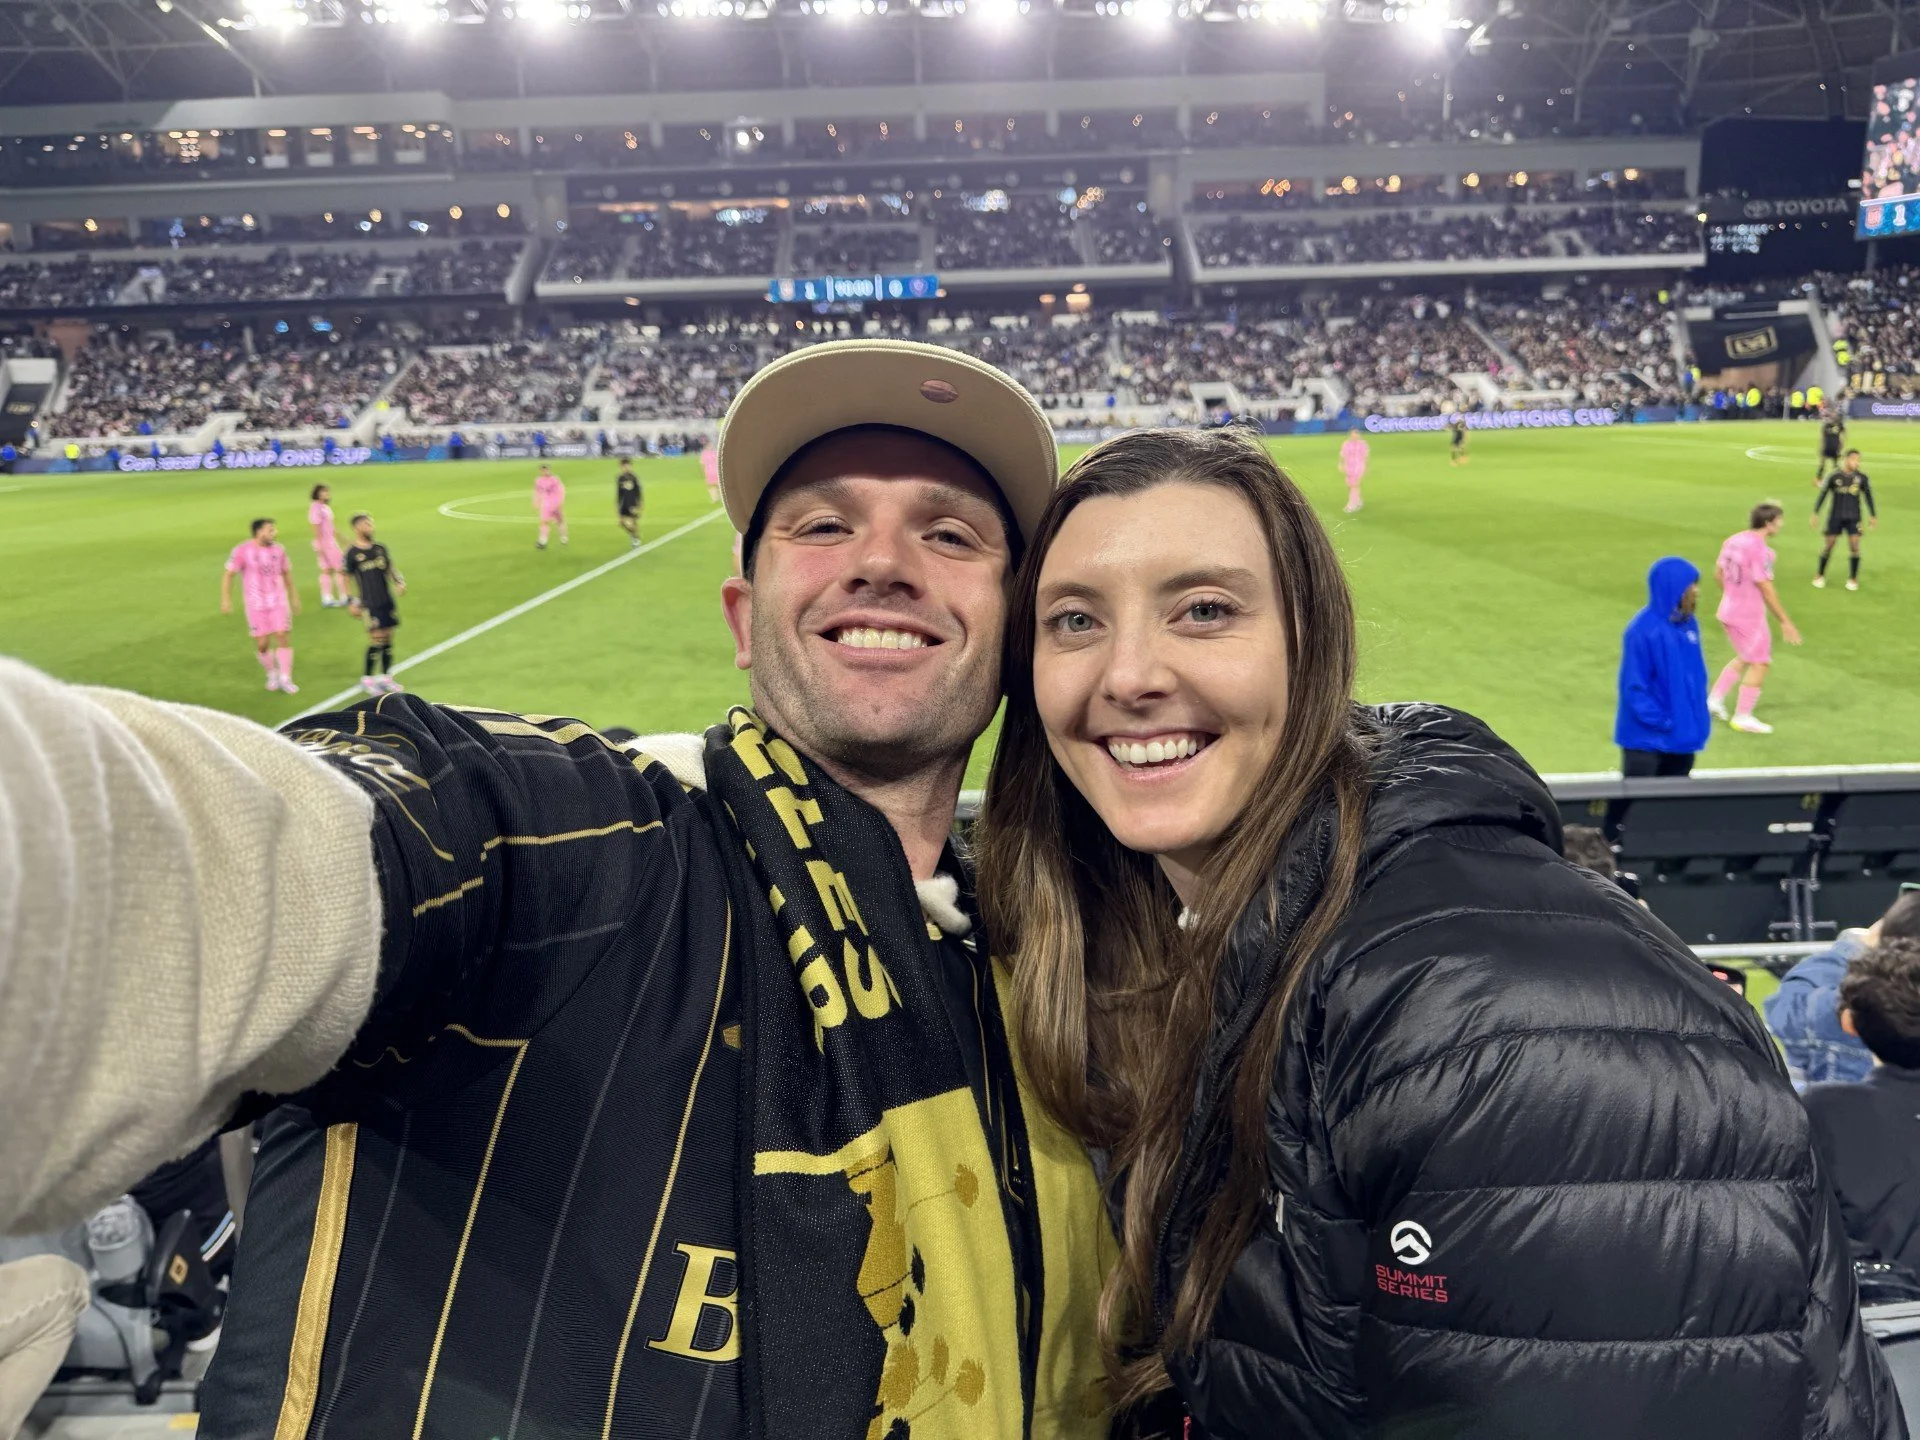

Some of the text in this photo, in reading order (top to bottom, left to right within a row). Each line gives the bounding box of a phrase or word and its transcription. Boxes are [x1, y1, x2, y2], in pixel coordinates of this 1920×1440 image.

[1774, 198, 1849, 216] TOYOTA
[1892, 204, 1907, 227] 1
[1375, 1264, 1447, 1288] SUMMIT
[1377, 1277, 1448, 1303] SERIES
